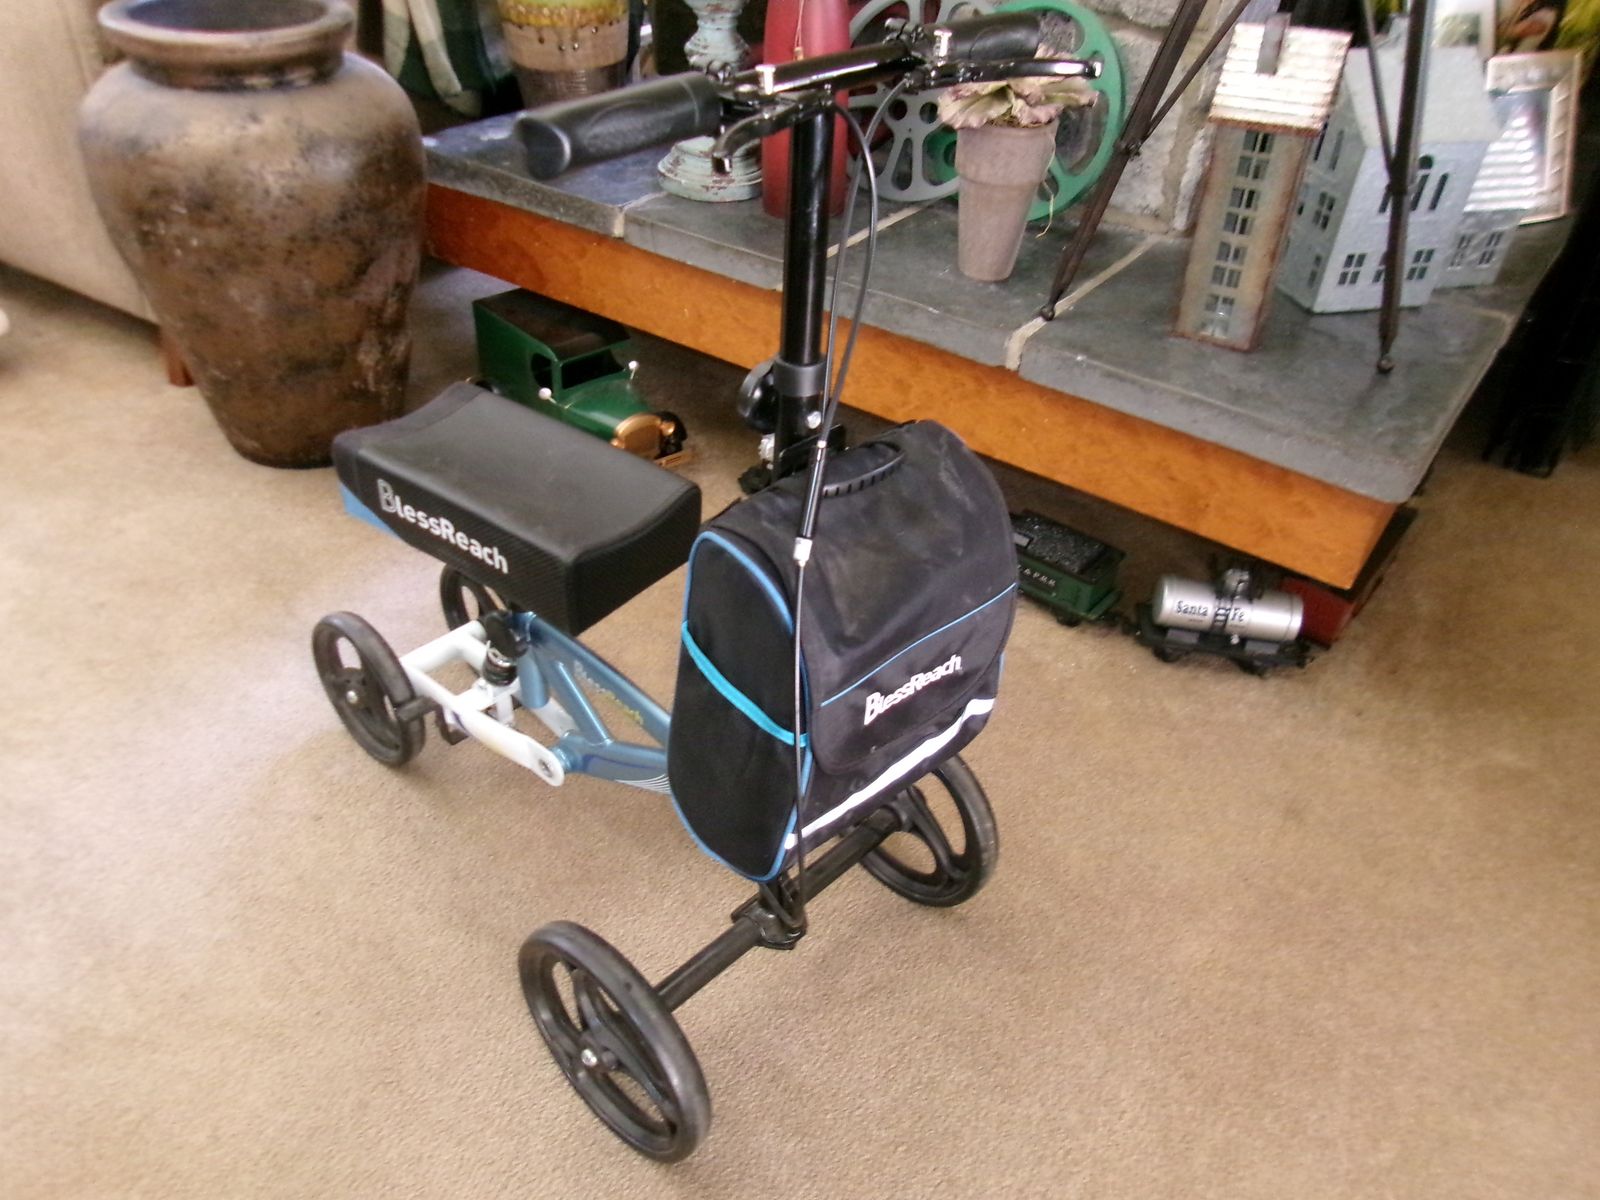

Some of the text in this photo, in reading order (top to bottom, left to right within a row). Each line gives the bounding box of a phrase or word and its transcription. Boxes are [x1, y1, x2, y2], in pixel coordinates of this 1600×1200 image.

[377, 478, 509, 575] BlessReach
[1176, 600, 1246, 622] Santa Fe
[863, 654, 964, 726] BlessReach
